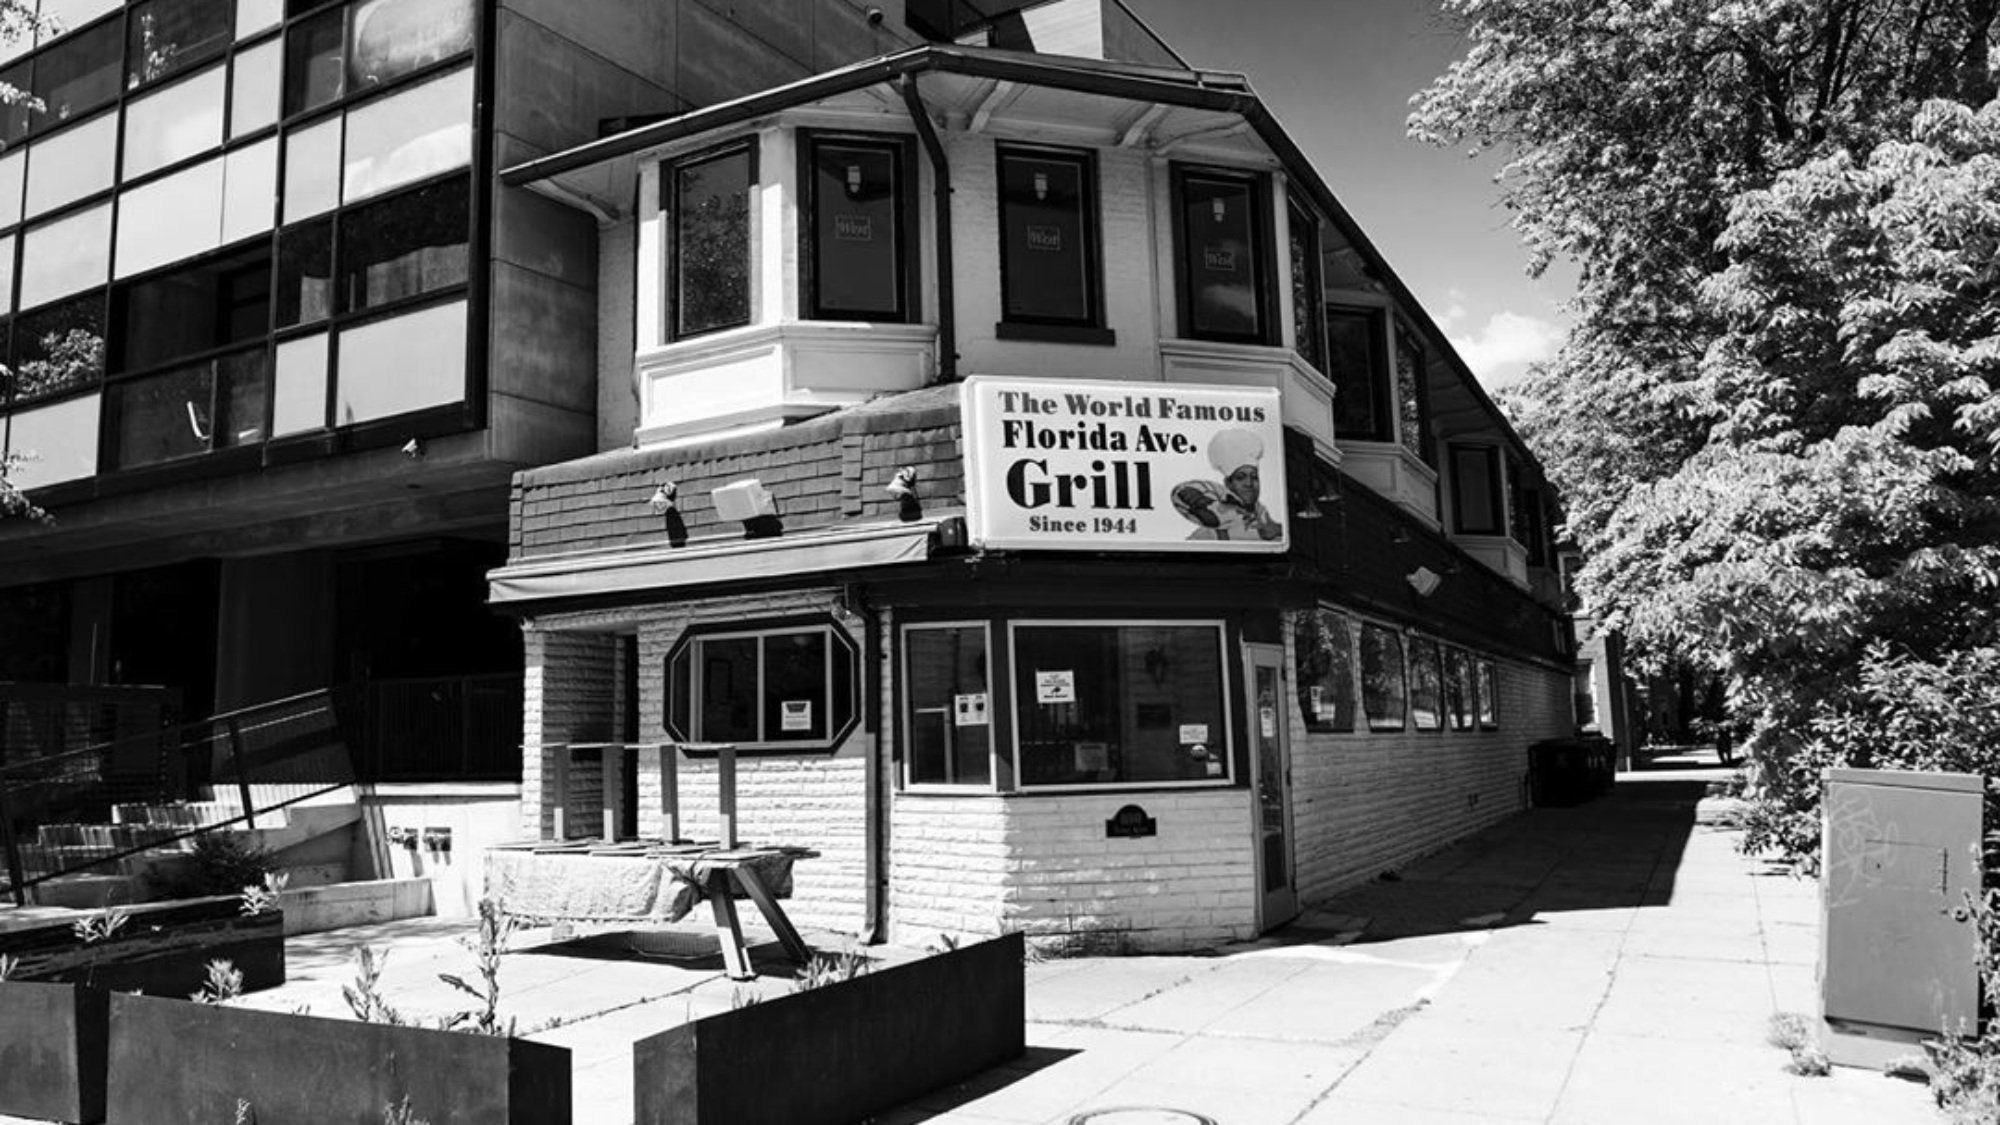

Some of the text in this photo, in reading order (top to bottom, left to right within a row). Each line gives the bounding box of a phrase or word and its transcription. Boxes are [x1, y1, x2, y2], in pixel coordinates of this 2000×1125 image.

[998, 391, 1266, 423] The World Famous
[1002, 420, 1198, 454] Florida Ave.
[1006, 459, 1155, 511] Grill
[1030, 516, 1137, 534] Since 1944
